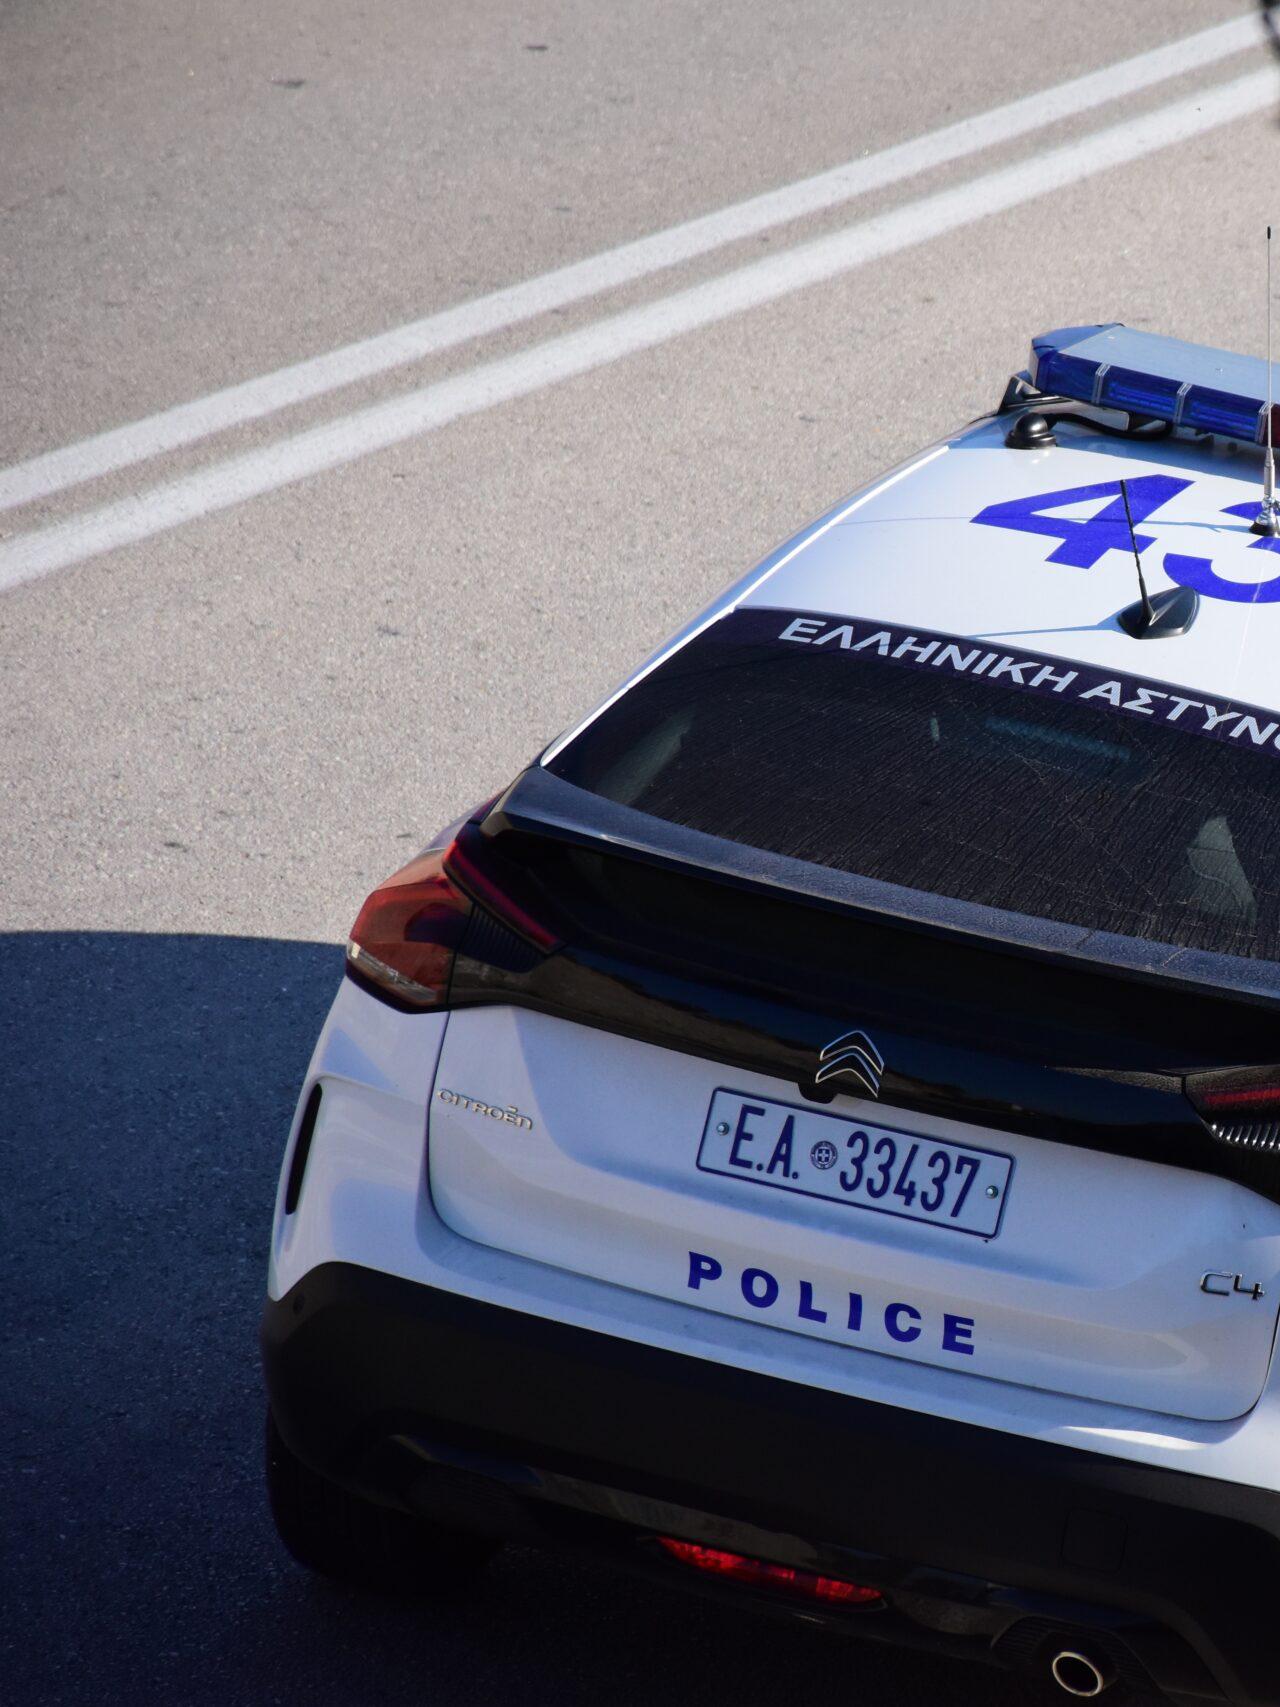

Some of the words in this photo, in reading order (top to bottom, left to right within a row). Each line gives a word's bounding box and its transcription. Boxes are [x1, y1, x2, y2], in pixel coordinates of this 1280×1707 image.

[778, 617, 1080, 693] ΕΛΛΗΝΙΚΗ
[840, 1131, 982, 1218] 33437
[687, 1251, 975, 1356] POLICE
[1200, 1268, 1265, 1301] C4
